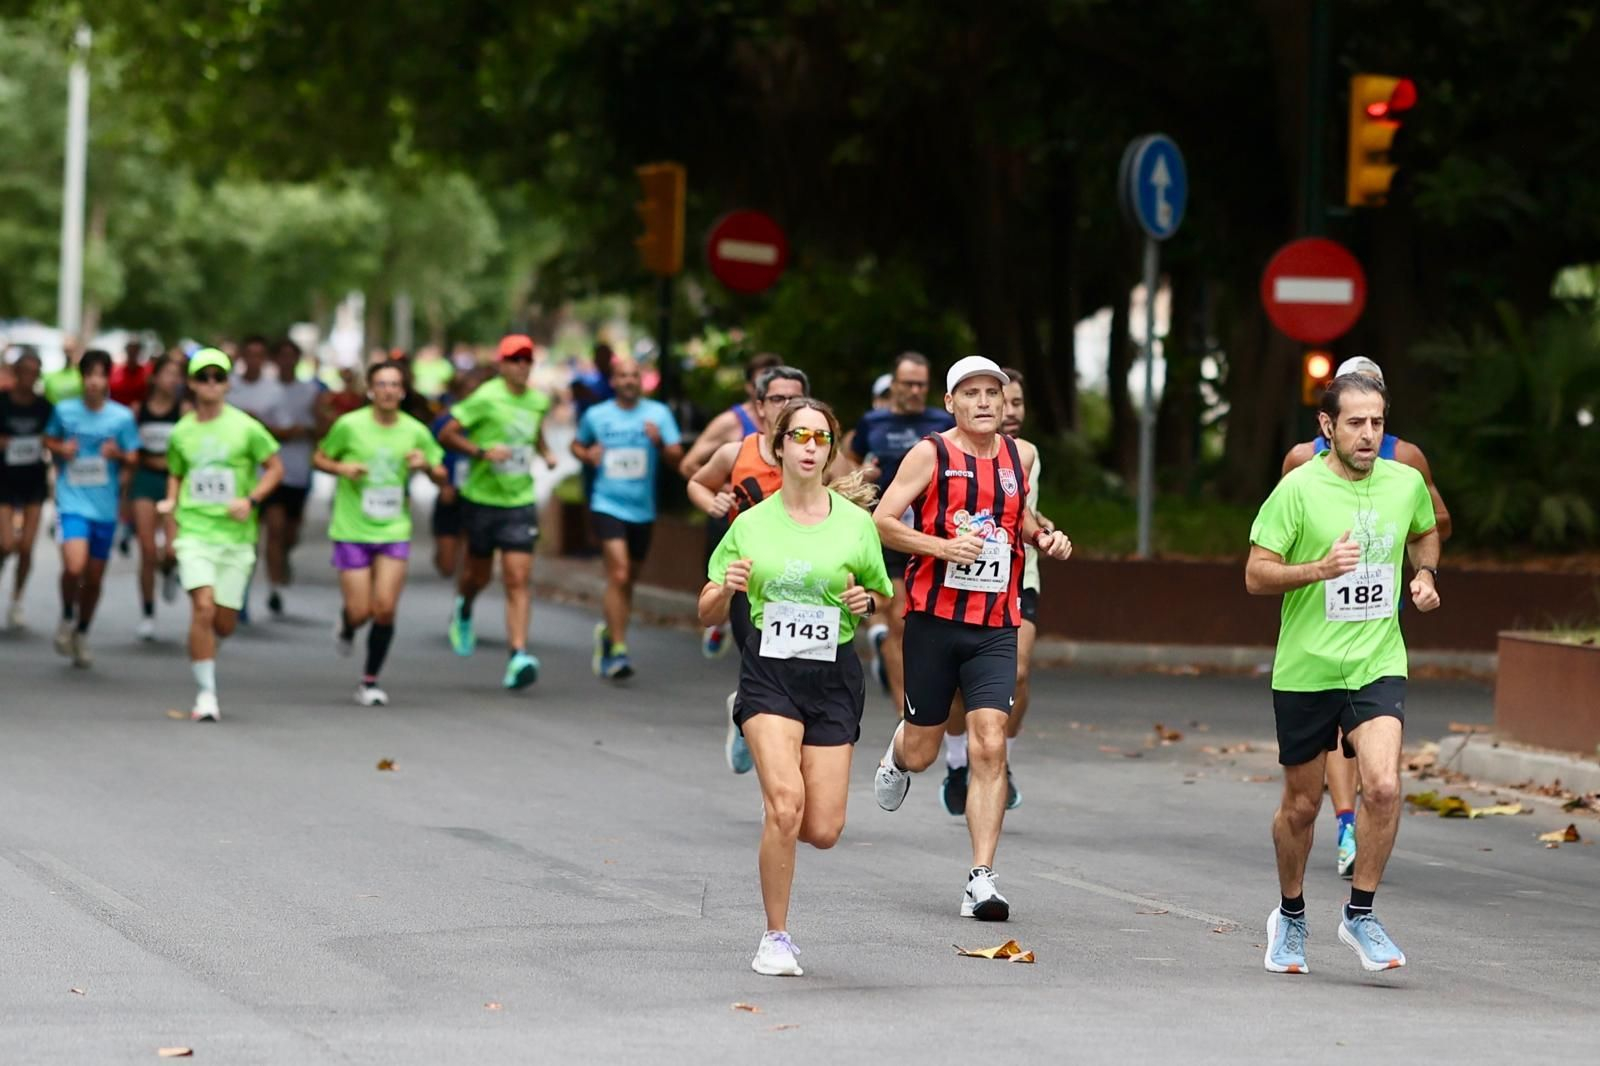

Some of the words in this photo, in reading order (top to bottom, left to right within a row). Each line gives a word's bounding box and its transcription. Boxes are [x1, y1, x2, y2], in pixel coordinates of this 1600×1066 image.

[956, 560, 1000, 577] 471
[1336, 584, 1384, 604] 182
[770, 620, 830, 641] 1143
